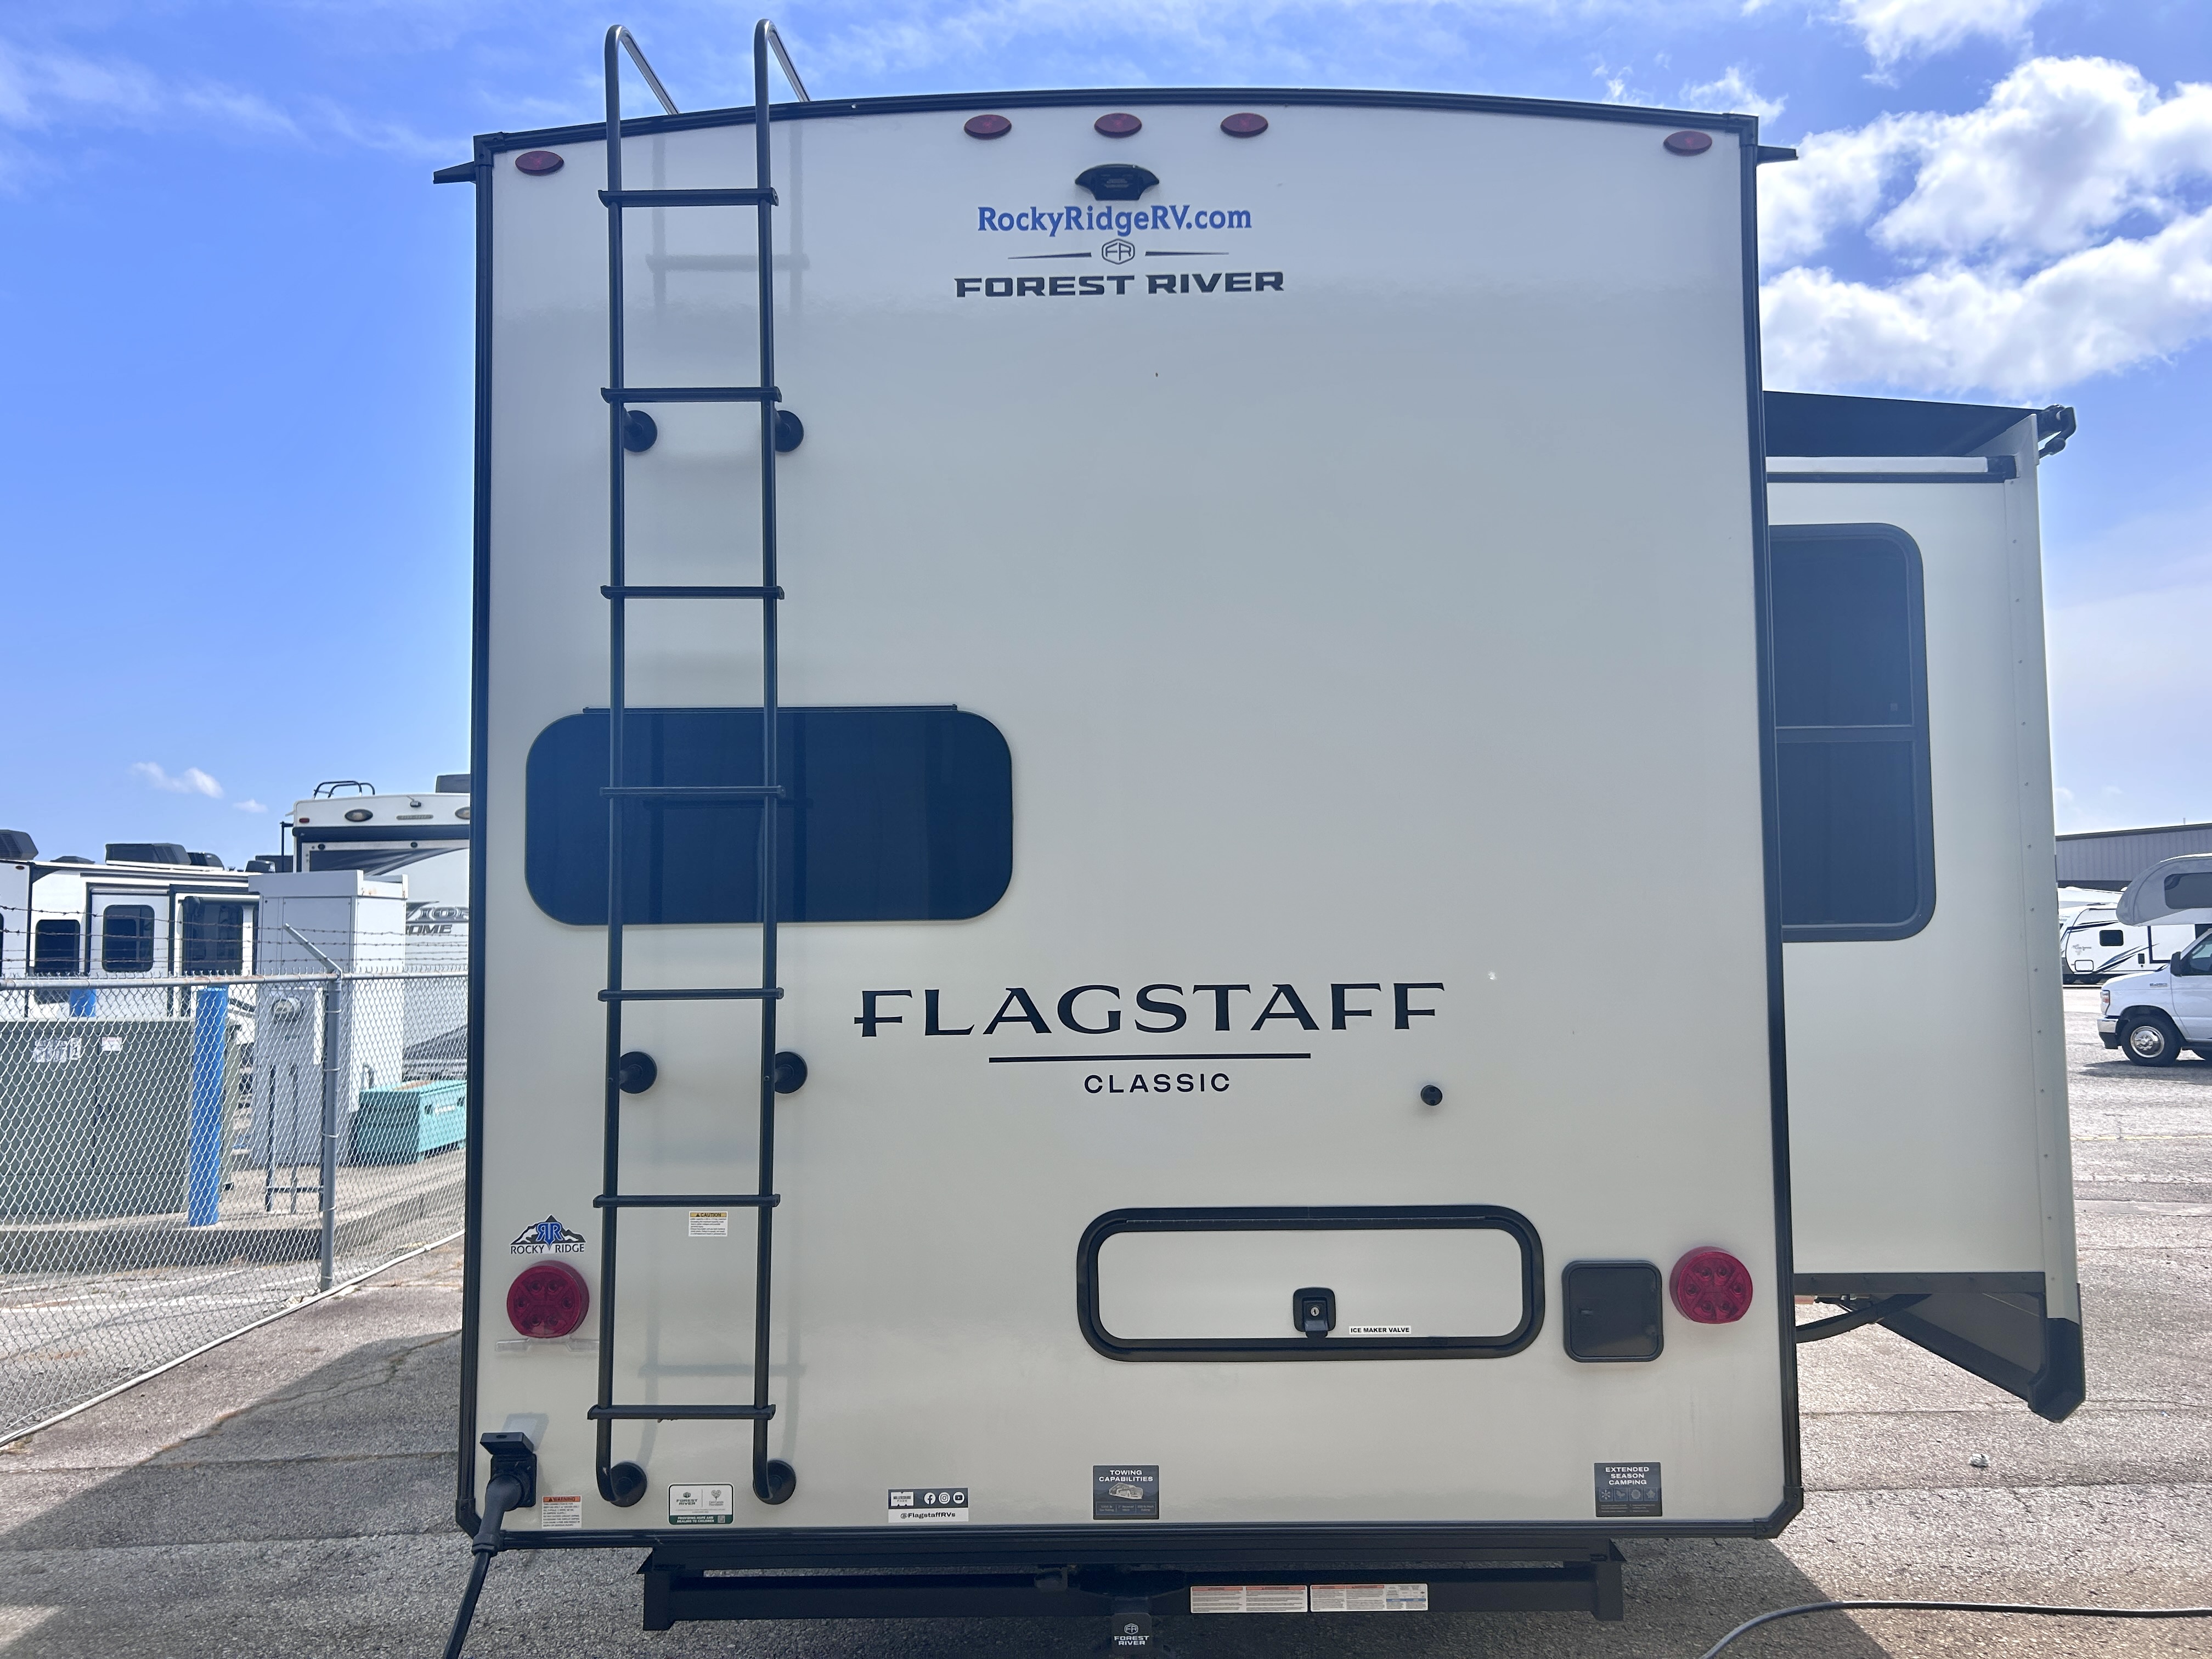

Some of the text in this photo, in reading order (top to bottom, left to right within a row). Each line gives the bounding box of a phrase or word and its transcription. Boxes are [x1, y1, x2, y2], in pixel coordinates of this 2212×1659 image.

[978, 205, 1252, 238] RockyRidgeRV.com
[954, 272, 1284, 298] FOREST RIVER
[854, 982, 1445, 1037] FLAGSTAFF
[1084, 1073, 1229, 1094] CLASSIC
[511, 1244, 585, 1255] ROCKY RIDGE
